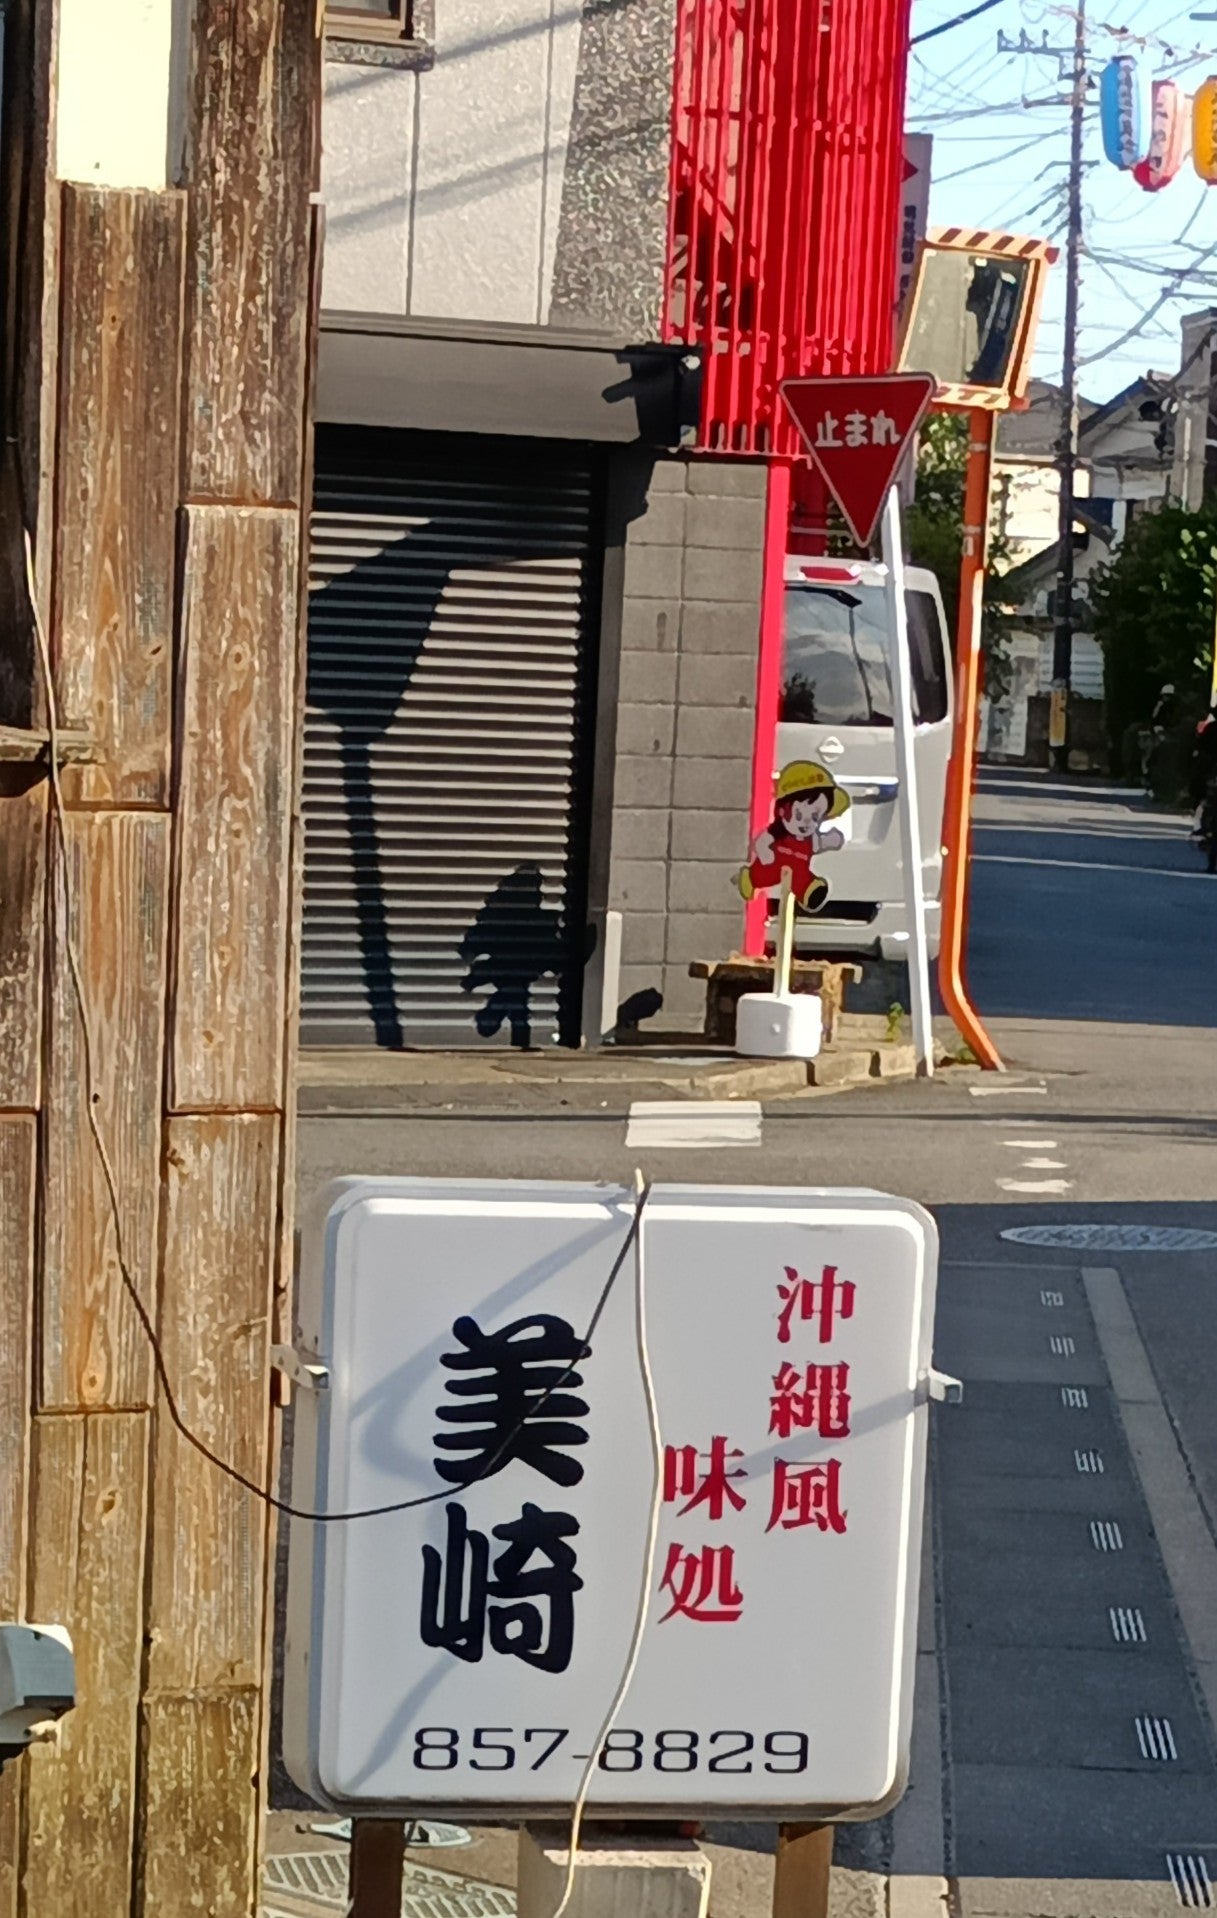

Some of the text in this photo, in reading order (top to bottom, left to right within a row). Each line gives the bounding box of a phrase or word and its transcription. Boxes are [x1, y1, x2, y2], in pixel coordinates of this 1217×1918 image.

[814, 409, 901, 448] 止まれ
[420, 1314, 592, 1674] 美崎
[767, 1265, 856, 1534] 沖縄風
[658, 1436, 748, 1625] 味処
[412, 1727, 810, 1775] 857-8829
